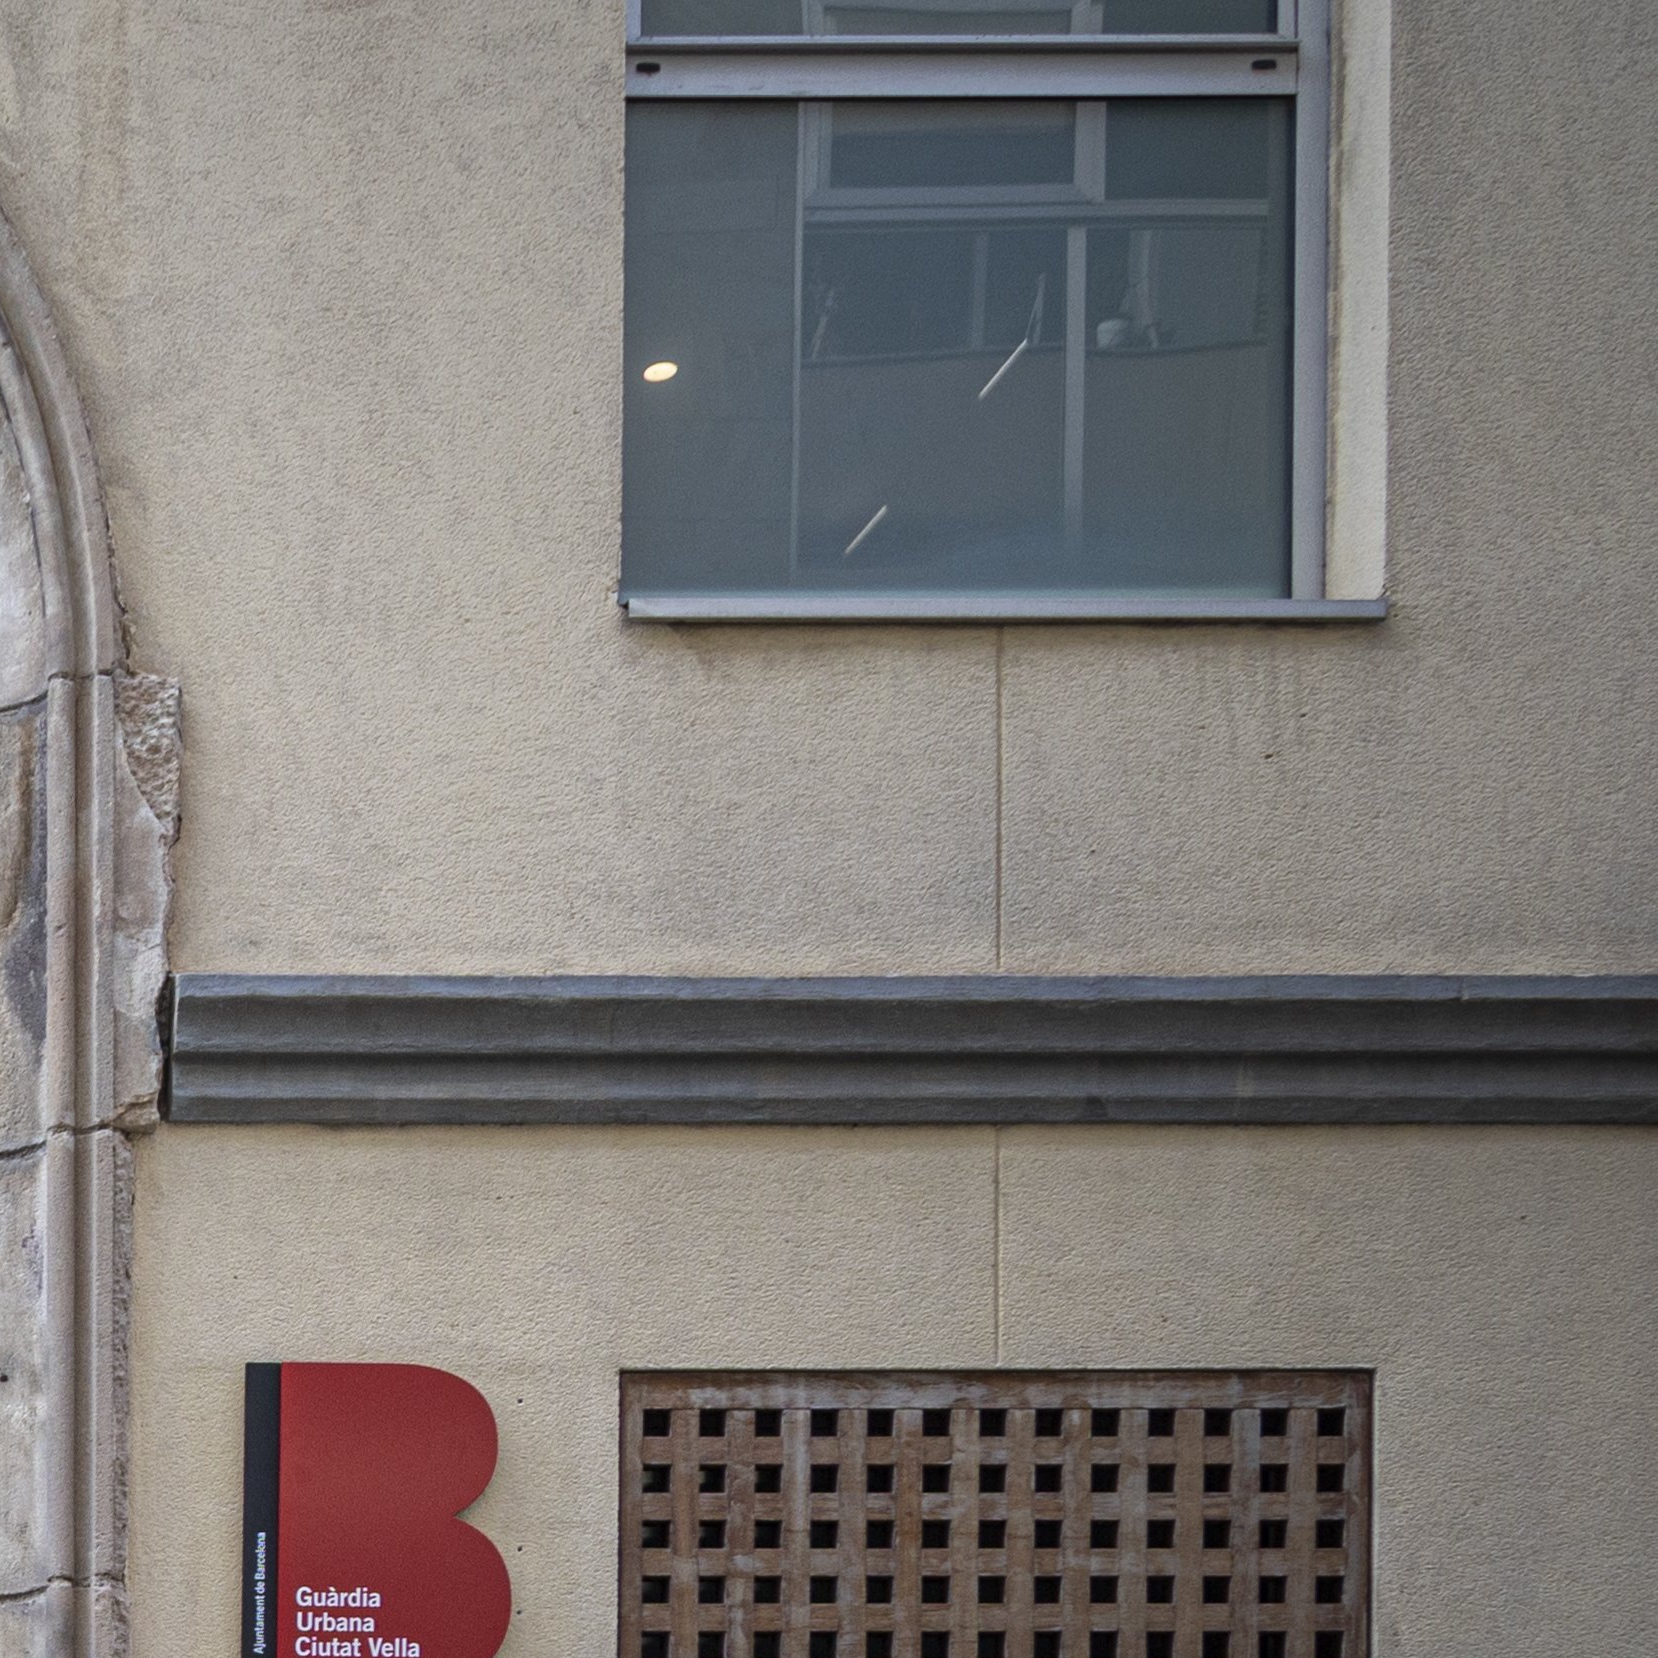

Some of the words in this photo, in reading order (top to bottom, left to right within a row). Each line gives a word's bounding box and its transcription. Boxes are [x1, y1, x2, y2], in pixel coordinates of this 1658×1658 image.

[254, 1531, 266, 1581] Barcelona
[254, 1581, 266, 1594] de
[295, 1586, 382, 1608] Guàrdia
[253, 1595, 266, 1655] Ajuntament
[295, 1611, 375, 1632] Urbana
[295, 1636, 362, 1658] Ciutat
[368, 1636, 421, 1658] Vella
